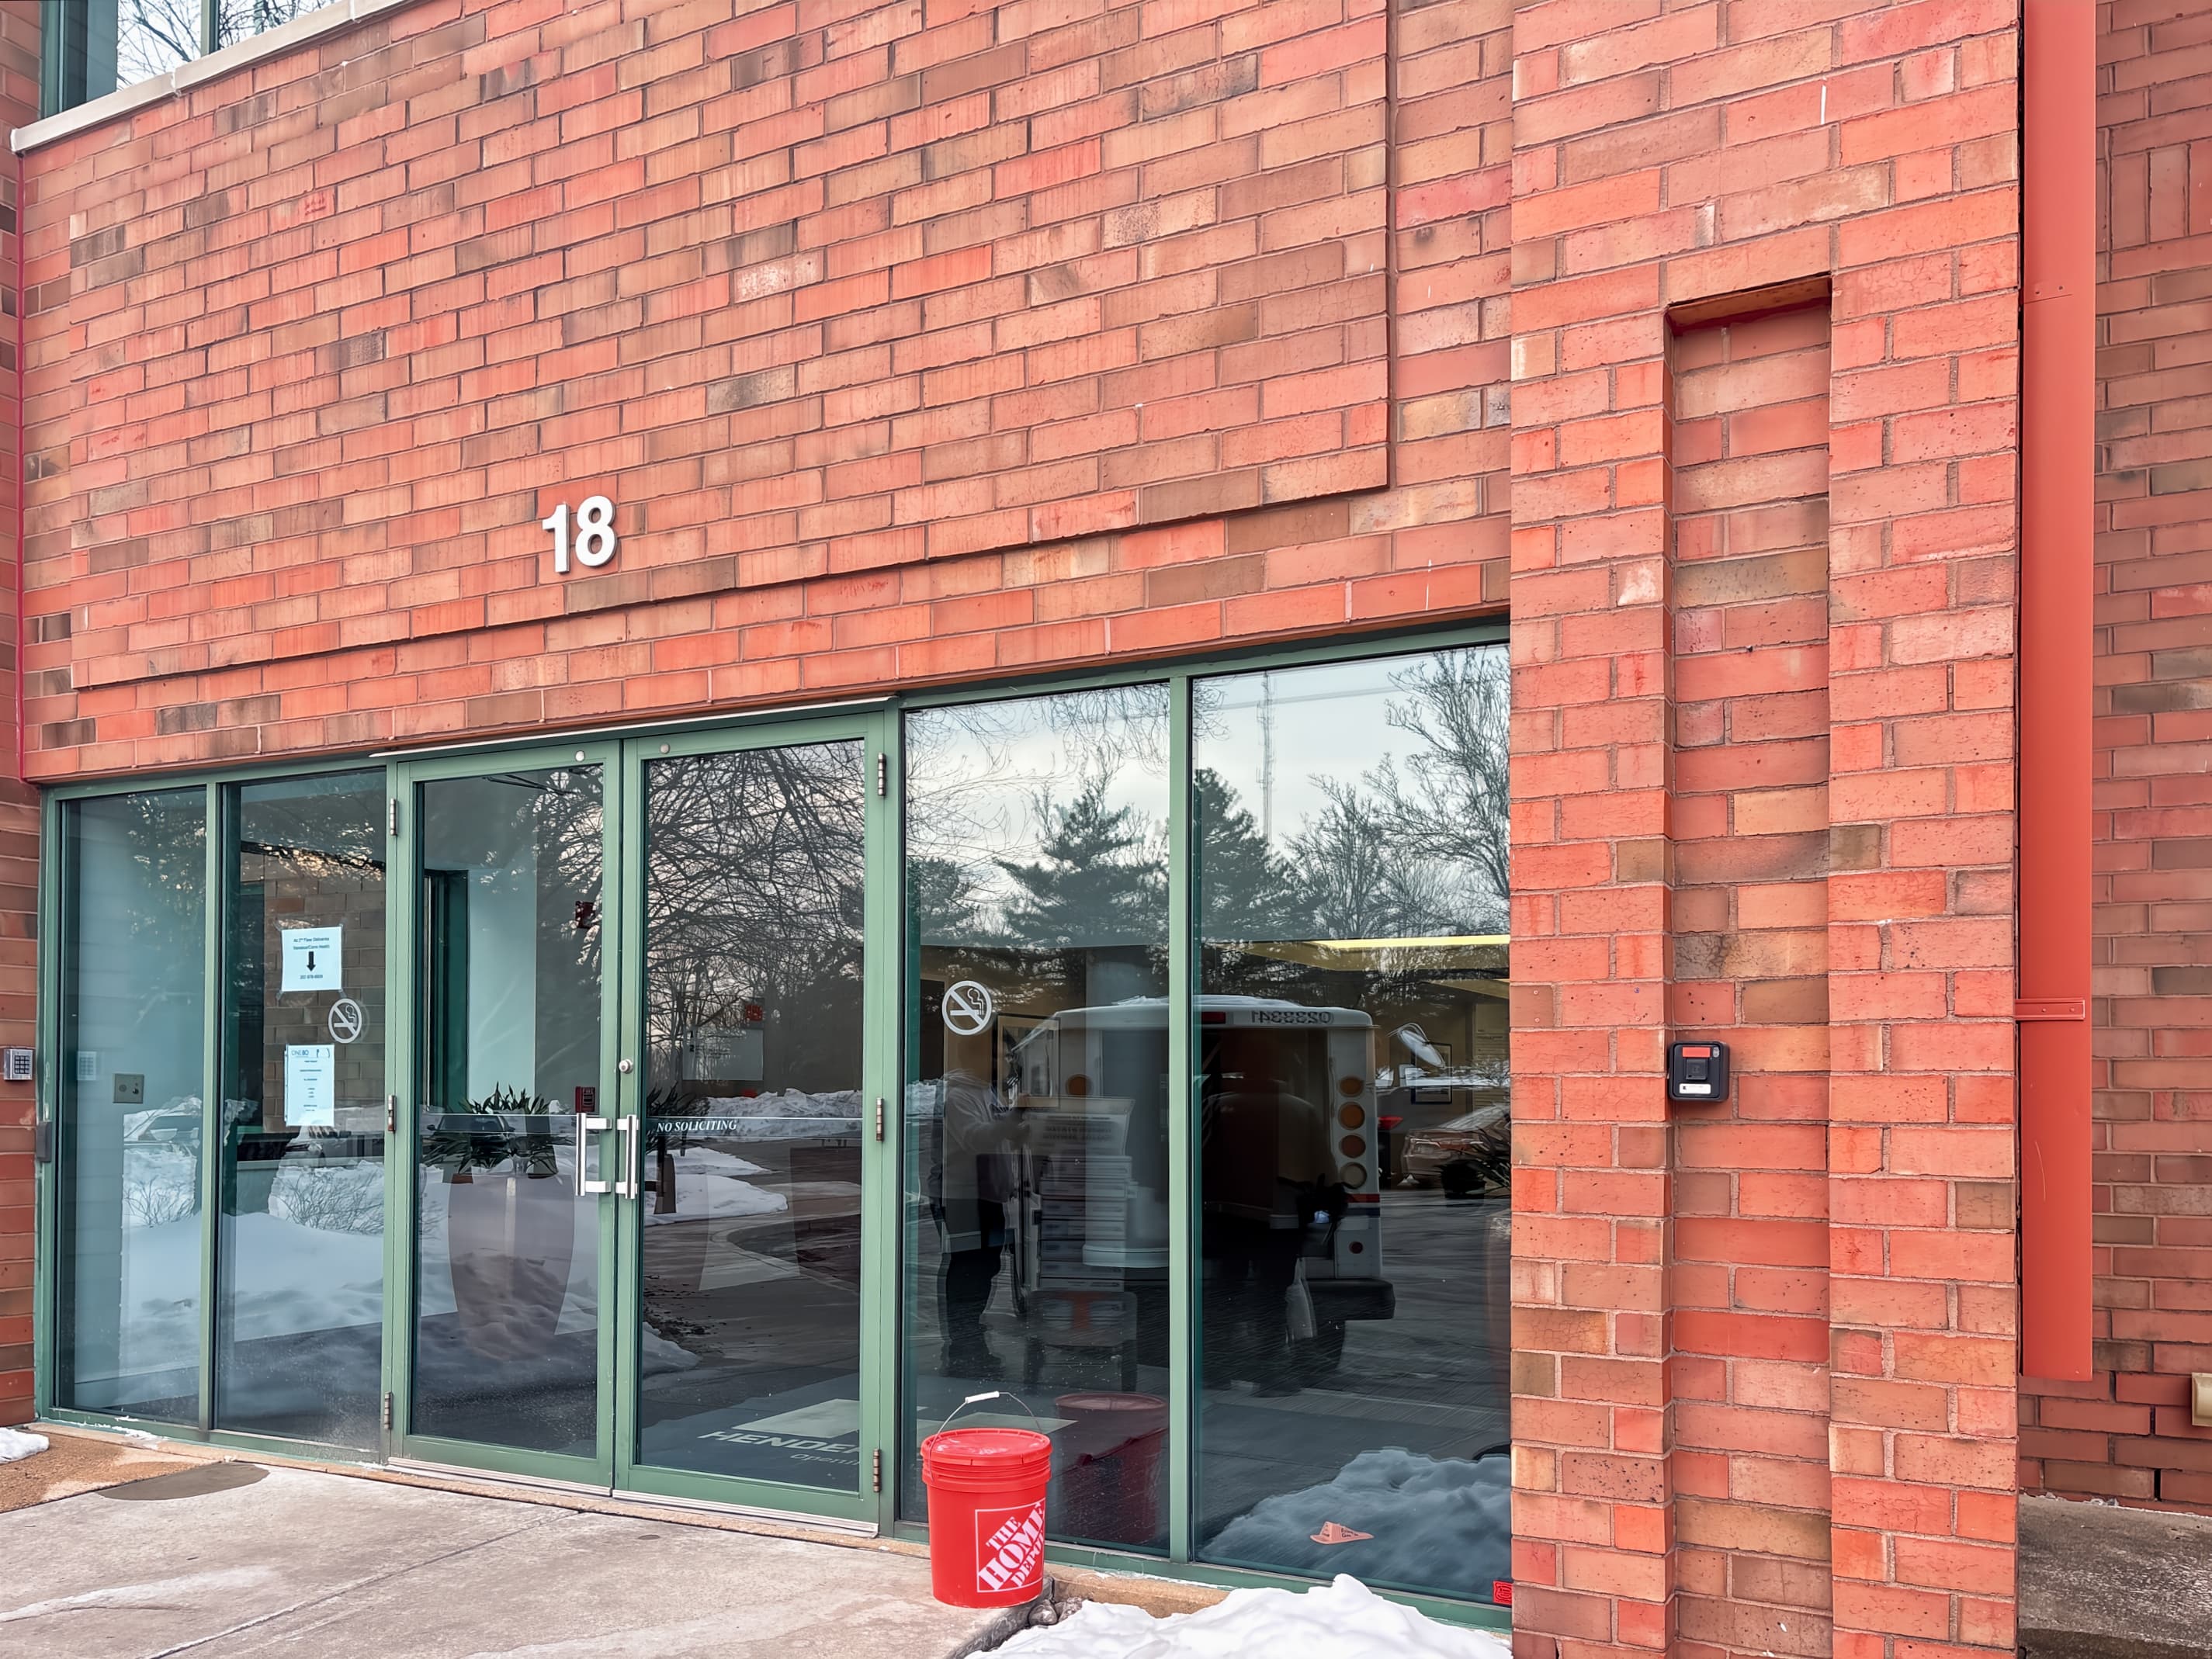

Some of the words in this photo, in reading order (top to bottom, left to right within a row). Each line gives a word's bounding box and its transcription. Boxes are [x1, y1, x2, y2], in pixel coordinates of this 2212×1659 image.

[542, 495, 618, 573] 18
[657, 1122, 672, 1132] NO
[674, 1120, 737, 1131] SOLICITING
[978, 1501, 1043, 1591] HOME
[985, 1515, 1021, 1550] THE
